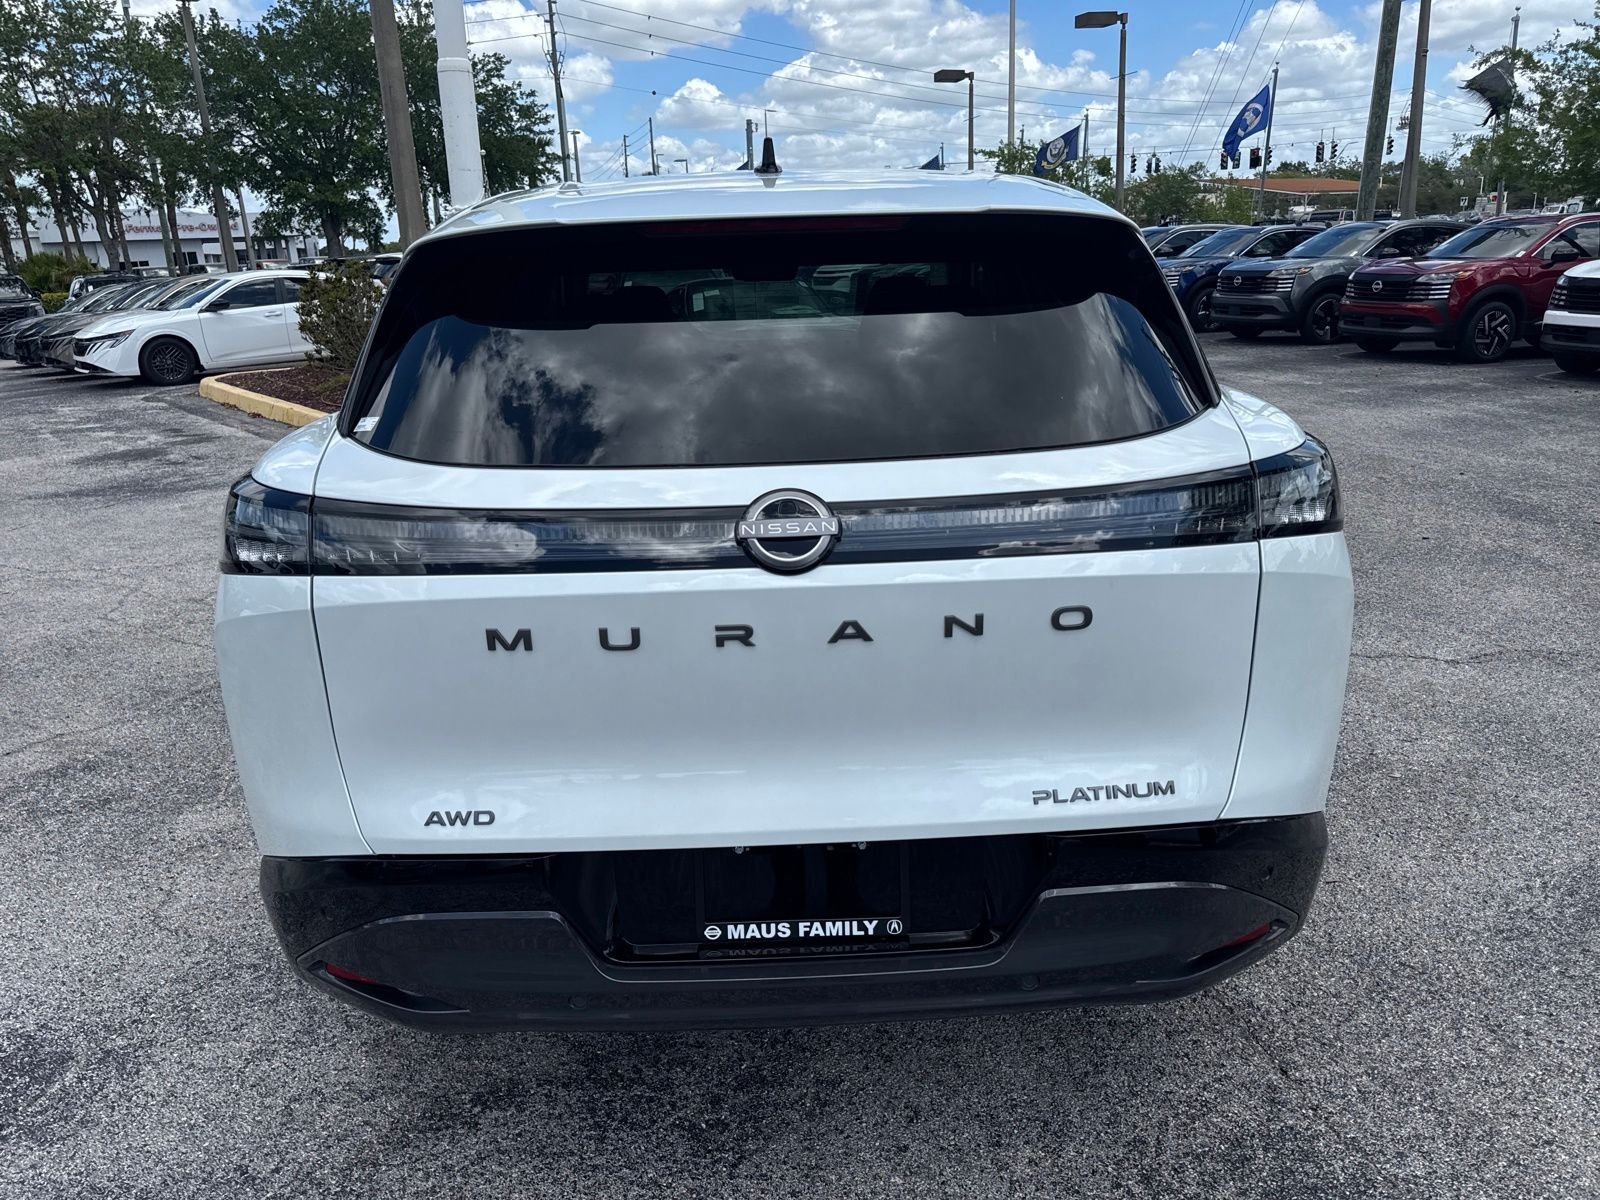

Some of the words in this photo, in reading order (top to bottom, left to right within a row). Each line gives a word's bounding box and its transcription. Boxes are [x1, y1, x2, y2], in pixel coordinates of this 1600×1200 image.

[126, 223, 163, 233] Ferma
[176, 221, 239, 232] Pre-Owd
[741, 520, 836, 535] NISSAN
[485, 605, 1093, 652] MURANO
[1032, 780, 1176, 805] PLATINUM
[423, 810, 496, 827] AWD
[727, 922, 792, 940] MAUS
[798, 920, 879, 937] FAMILY
